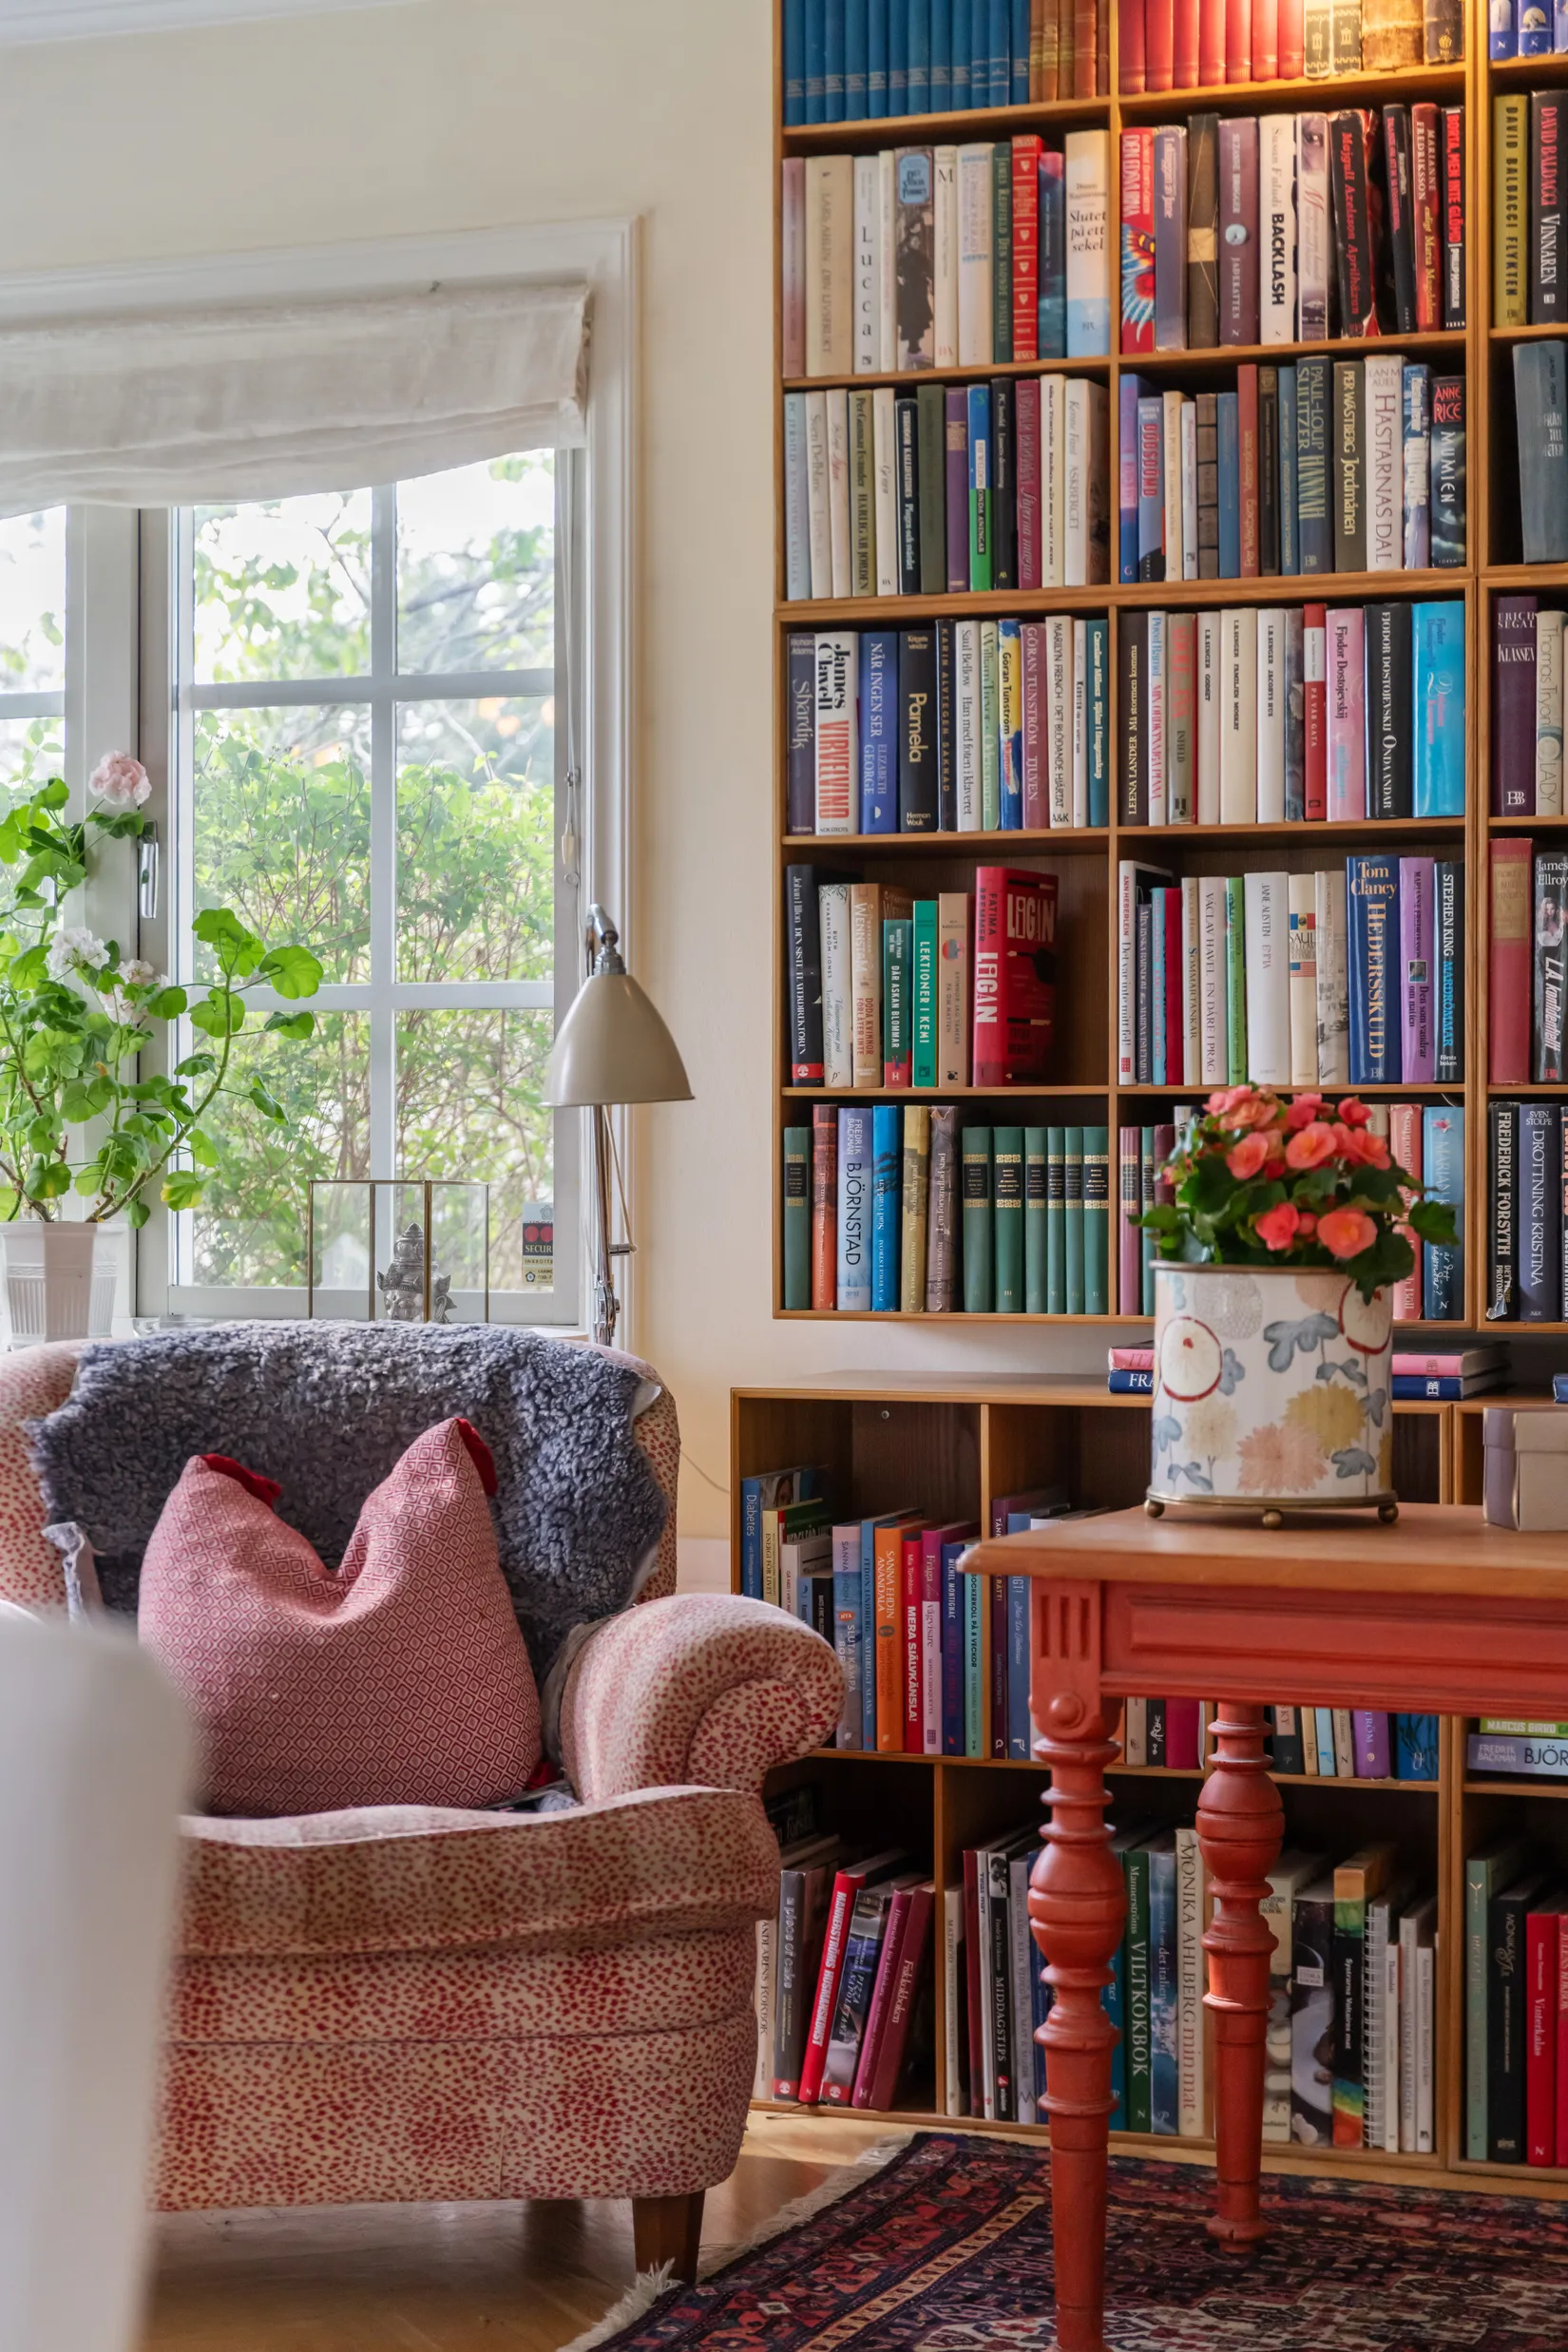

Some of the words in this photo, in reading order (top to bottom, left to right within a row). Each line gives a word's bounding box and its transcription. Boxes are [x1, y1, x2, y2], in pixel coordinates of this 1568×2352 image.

[1272, 127, 1282, 163] Susan
[1505, 106, 1519, 149] DAVID
[1540, 106, 1557, 143] DAVID
[1340, 132, 1354, 181] Majgull
[1416, 122, 1426, 200] FREDRIKSSON
[1427, 129, 1436, 191] MARIANNE
[1540, 146, 1557, 205] BALDACCI
[1272, 167, 1282, 207] Faludi
[1506, 157, 1519, 228] BALDACCI
[1069, 210, 1107, 224] Slutet
[1344, 184, 1356, 239] Axelsson
[1072, 238, 1105, 252] sekel
[1272, 213, 1285, 306] BACKLASH
[1540, 213, 1559, 283] VINNAREN
[1348, 244, 1360, 315] Aprilhäxan
[1506, 237, 1519, 296] FLYKTEN
[1344, 371, 1354, 390] PER
[1433, 386, 1461, 400] ANNE
[1297, 367, 1310, 449] SULITZER
[1311, 366, 1324, 449] PAUL-LOUP
[1343, 392, 1356, 452] WÄSTBERG
[1433, 402, 1462, 423] RICE
[1141, 424, 1159, 497] DÖDSDÖMD
[1441, 431, 1455, 503] MUMIEN
[1298, 455, 1325, 519] HANNAH
[1341, 456, 1359, 535] Jordmånen
[1375, 525, 1392, 563] DAL
[962, 629, 971, 651] Saul
[1054, 622, 1062, 661] MARILYN
[1336, 626, 1348, 658] Fjodor
[1382, 612, 1391, 653] FJODOR
[1498, 621, 1535, 629] SEGAL
[870, 642, 884, 669] NÄR
[963, 653, 972, 687] Bellow
[1027, 627, 1039, 672] GÖRAN
[1498, 643, 1535, 662] KLASSEN
[1540, 625, 1558, 683] Thomas
[818, 643, 833, 710] Clavell
[833, 643, 851, 709] James
[871, 672, 883, 712] INGEN
[1335, 660, 1348, 718] Dostojevskij
[1383, 657, 1392, 731] DOSTOJEVSKIJ
[790, 679, 814, 750] Shardik
[963, 697, 972, 717] Han
[1027, 677, 1039, 745] TUNSTRÖM
[1055, 705, 1063, 721] DET
[1539, 685, 1558, 726] Tryon
[870, 716, 882, 737] SER
[908, 693, 928, 762] Pamela
[963, 719, 972, 741] med
[963, 744, 973, 769] foten
[1055, 724, 1066, 771] BLÖDANDE
[1383, 736, 1397, 772] ONDA
[819, 719, 849, 818] VIRVELVIND
[864, 744, 873, 795] GEORGE
[877, 744, 887, 794] ELIZABETH
[1026, 755, 1038, 800] TJUVEN
[1539, 762, 1557, 803] LADY
[963, 776, 974, 814] klaveret
[1055, 774, 1065, 808] HJÄRTAT
[1383, 773, 1391, 808] ANDAR
[1357, 862, 1389, 878] Tom
[1538, 860, 1568, 872] James
[1538, 873, 1568, 889] Ellroy
[1350, 879, 1397, 899] Clancy
[1443, 874, 1453, 926] STEPHEN
[988, 893, 997, 935] FATIMA
[1206, 892, 1215, 935] VÁCLAV
[854, 903, 868, 971] WENNSTAM
[1121, 942, 1131, 962] Det
[1206, 939, 1214, 976] HAVEL
[1444, 928, 1453, 956] KING
[891, 966, 900, 981] DÄR
[920, 942, 929, 1003] LEKTIONER
[976, 952, 998, 1023] LIGAN
[1367, 902, 1386, 1058] HEDERSSKULD
[1544, 957, 1563, 981] L.A.
[1121, 982, 1130, 1002] inte
[1206, 983, 1214, 997] EN
[1420, 985, 1428, 1004] Den
[1443, 961, 1453, 1047] MARDRÖMMAR
[856, 998, 866, 1035] FÖRLÅTER
[920, 1017, 929, 1043] KEMI
[1121, 1004, 1131, 1027] mitt
[1206, 1002, 1216, 1031] DÅRE
[1544, 984, 1561, 1052] konfidentiellt
[1121, 1029, 1131, 1045] fel!
[1207, 1043, 1215, 1072] PRAG
[1419, 1025, 1428, 1059] vandrar
[1498, 1112, 1511, 1187] FREDERICK
[1532, 1131, 1544, 1217] DROTTNING
[846, 1162, 865, 1266] BJÖRNSTAD
[1497, 1193, 1511, 1255] FORSYTH
[525, 1244, 552, 1253] SECUR
[1531, 1223, 1543, 1287] KRISTINA
[746, 1495, 756, 1537] Diabetes
[886, 1551, 894, 1586] SANNA
[886, 1587, 895, 1619] EHDIN
[947, 1583, 956, 1618] MONTIGNAC
[846, 1624, 855, 1654] SLUTA
[908, 1606, 916, 1639] MERA
[848, 1657, 856, 1692] KÄMPA
[908, 1642, 918, 1722] SJÄLVKÄNSLA!
[1478, 1753, 1516, 1763] BACKMAN
[1479, 1744, 1516, 1754] FREDRIK
[1129, 1865, 1142, 1935] Mannerströms
[1180, 1844, 1196, 1923] MONIKA
[825, 1891, 847, 1968] MANNERSTRÖMS
[852, 1975, 865, 2004] PIZZA
[891, 1960, 914, 2023] Fiskkokboken
[1181, 1932, 1196, 2023] AHLBERG
[1345, 1958, 1353, 1996] Systrarna
[812, 1969, 833, 2047] HUSMANSKONST
[1130, 1941, 1148, 2077] VILTKOKBOK
[1345, 1998, 1353, 2032] Voltaires
[1533, 1998, 1546, 2056] Vinterkalas
[1183, 2027, 1199, 2070] min
[1183, 2073, 1198, 2111] mat
